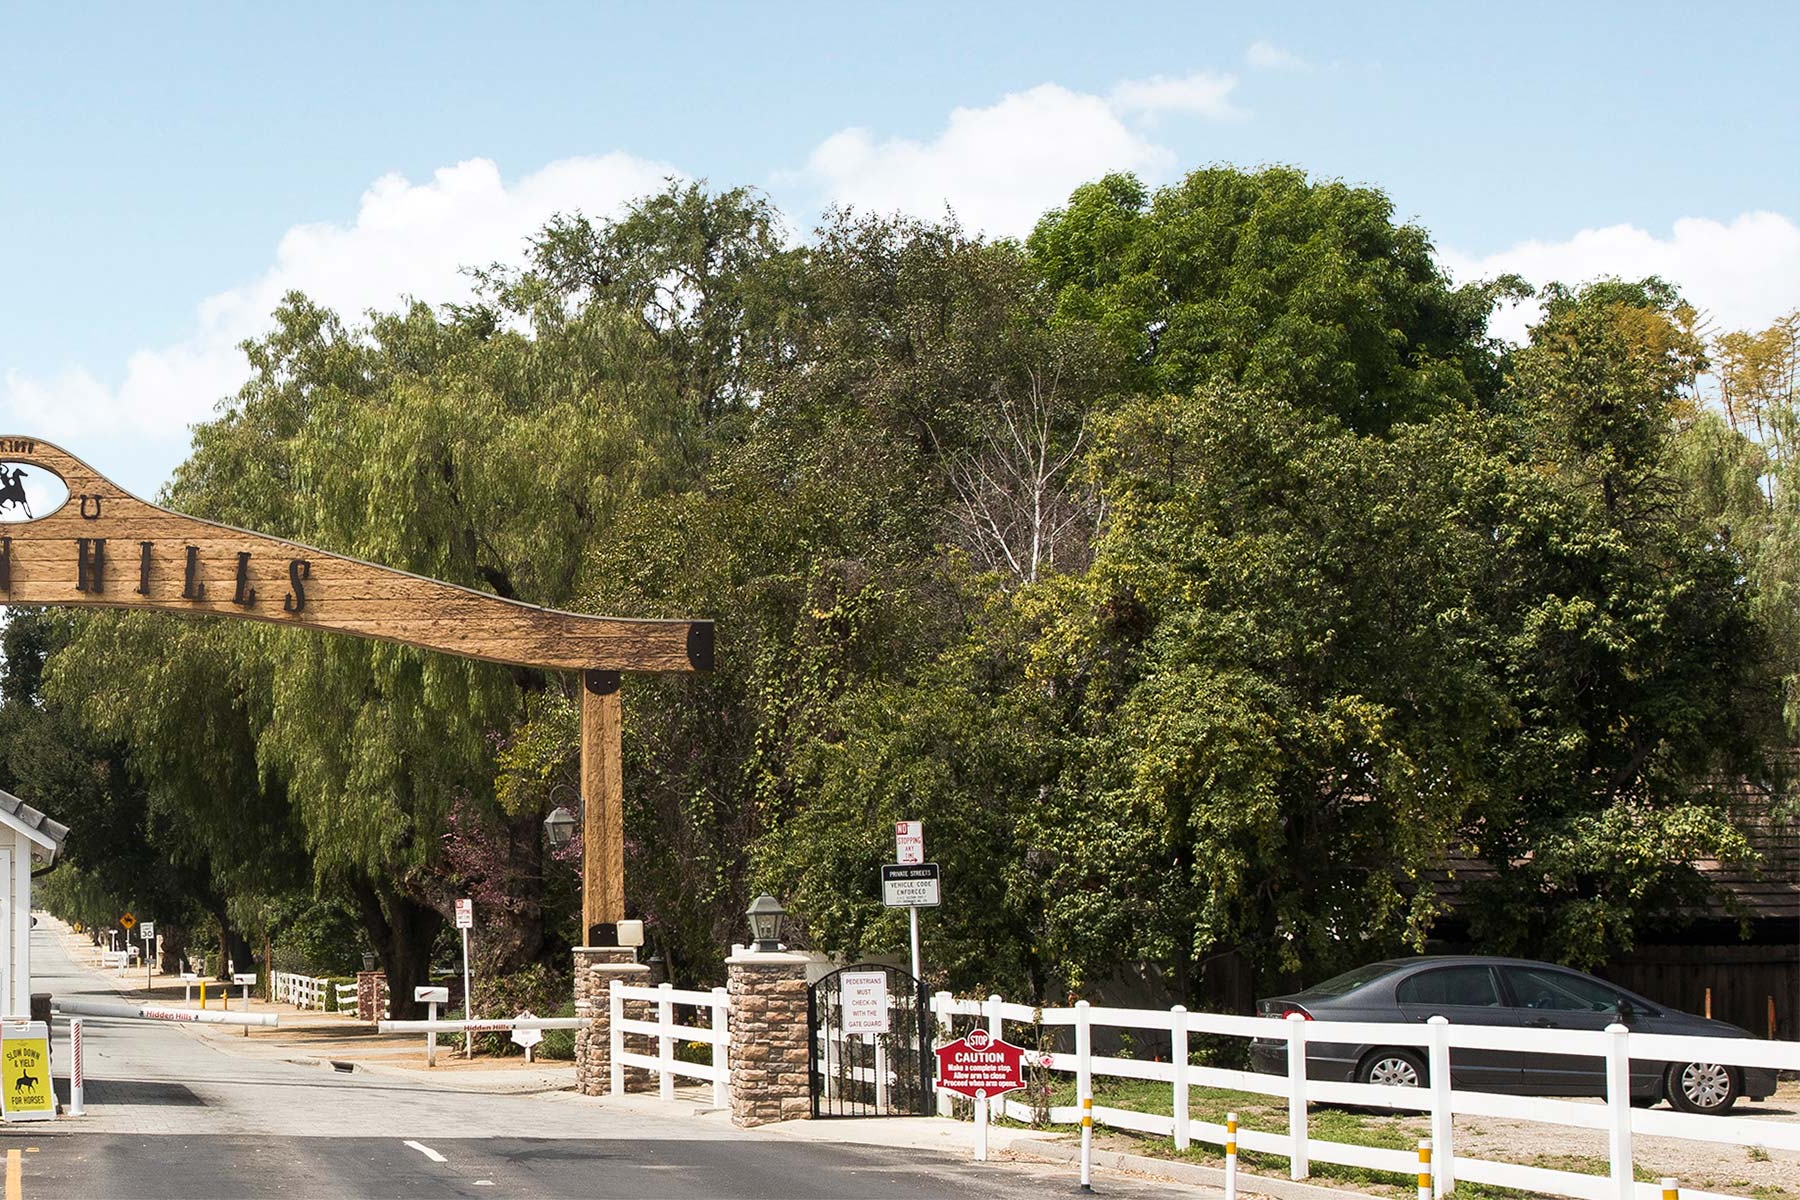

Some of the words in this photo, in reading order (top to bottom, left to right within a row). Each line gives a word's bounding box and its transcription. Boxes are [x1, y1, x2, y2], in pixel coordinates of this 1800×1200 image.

[75, 537, 311, 613] HILLS
[897, 824, 907, 834] NO
[897, 837, 921, 845] STOPPING
[910, 869, 931, 877] STREETS
[142, 930, 152, 938] 30
[146, 1010, 174, 1020] Hidden
[175, 1013, 192, 1021] Hills
[970, 1035, 988, 1046] STOP
[6, 1048, 22, 1061] SLOW
[23, 1048, 41, 1060] DOWN
[955, 1052, 1005, 1063] CAUTION
[20, 1059, 35, 1068] YIELD
[969, 1064, 997, 1072] complete
[997, 1064, 1012, 1072] stop.
[943, 1079, 968, 1087] Proceed
[11, 1096, 23, 1105] FOR
[24, 1096, 45, 1104] HORSES
